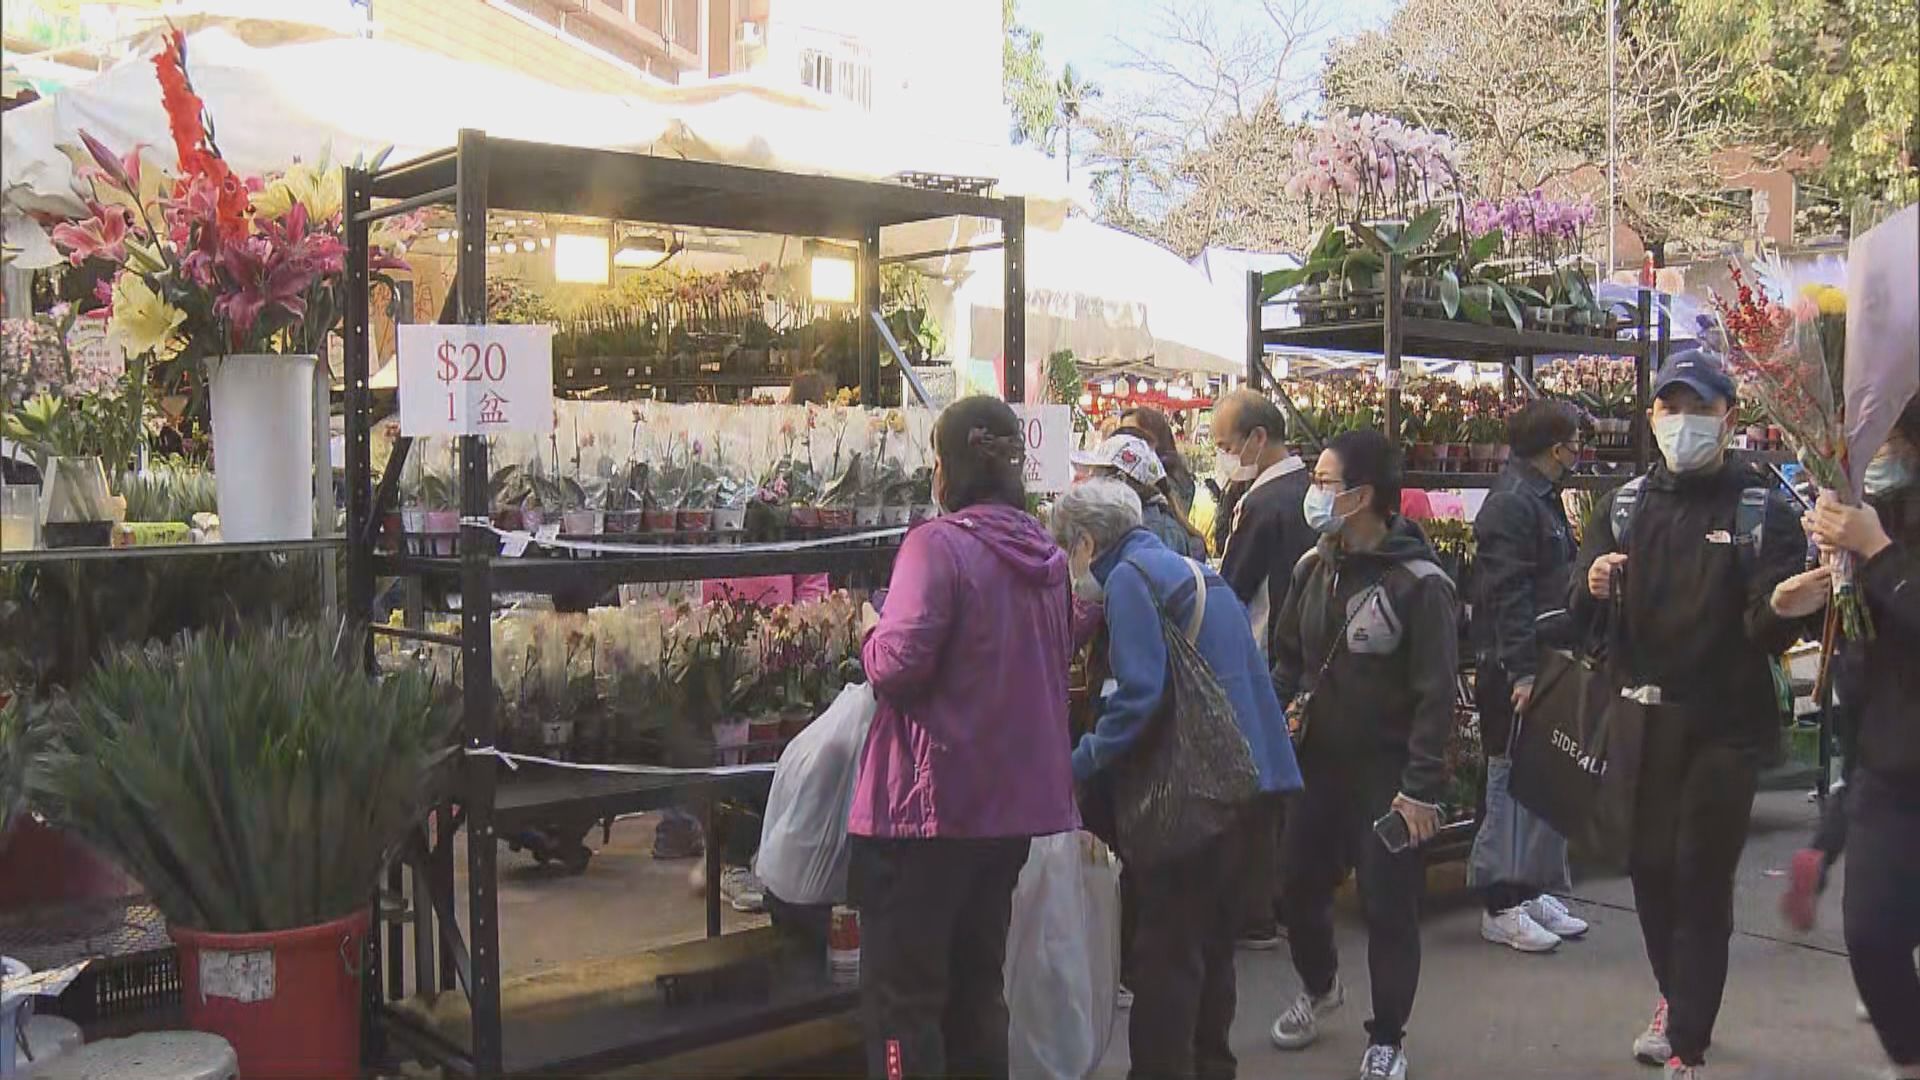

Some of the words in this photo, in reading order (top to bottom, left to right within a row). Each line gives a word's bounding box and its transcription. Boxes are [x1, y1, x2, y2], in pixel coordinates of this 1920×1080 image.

[437, 340, 507, 386] $20
[447, 392, 457, 422] 1
[476, 388, 510, 425] 盆
